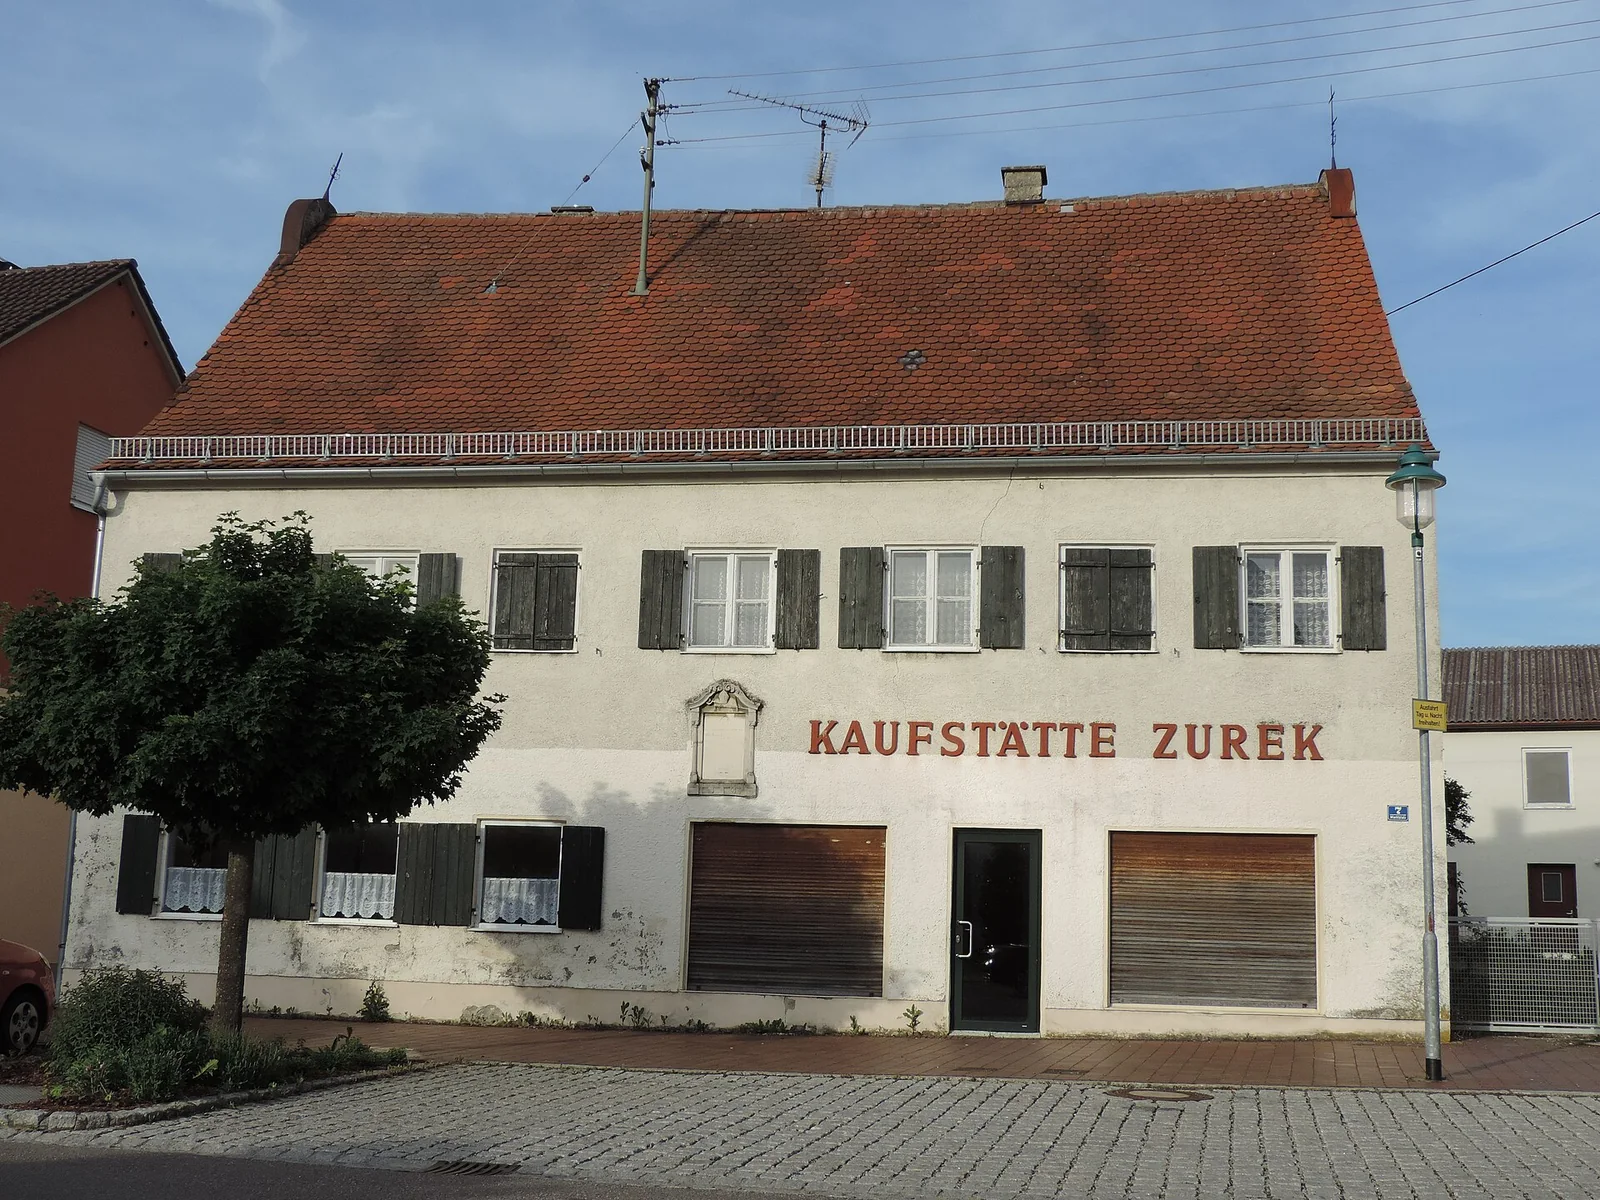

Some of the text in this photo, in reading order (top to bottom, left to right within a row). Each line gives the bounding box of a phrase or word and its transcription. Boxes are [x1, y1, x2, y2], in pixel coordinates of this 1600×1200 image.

[1416, 711, 1424, 719] Tag
[808, 719, 1324, 760] KAUFSTÄTTE ZUREK
